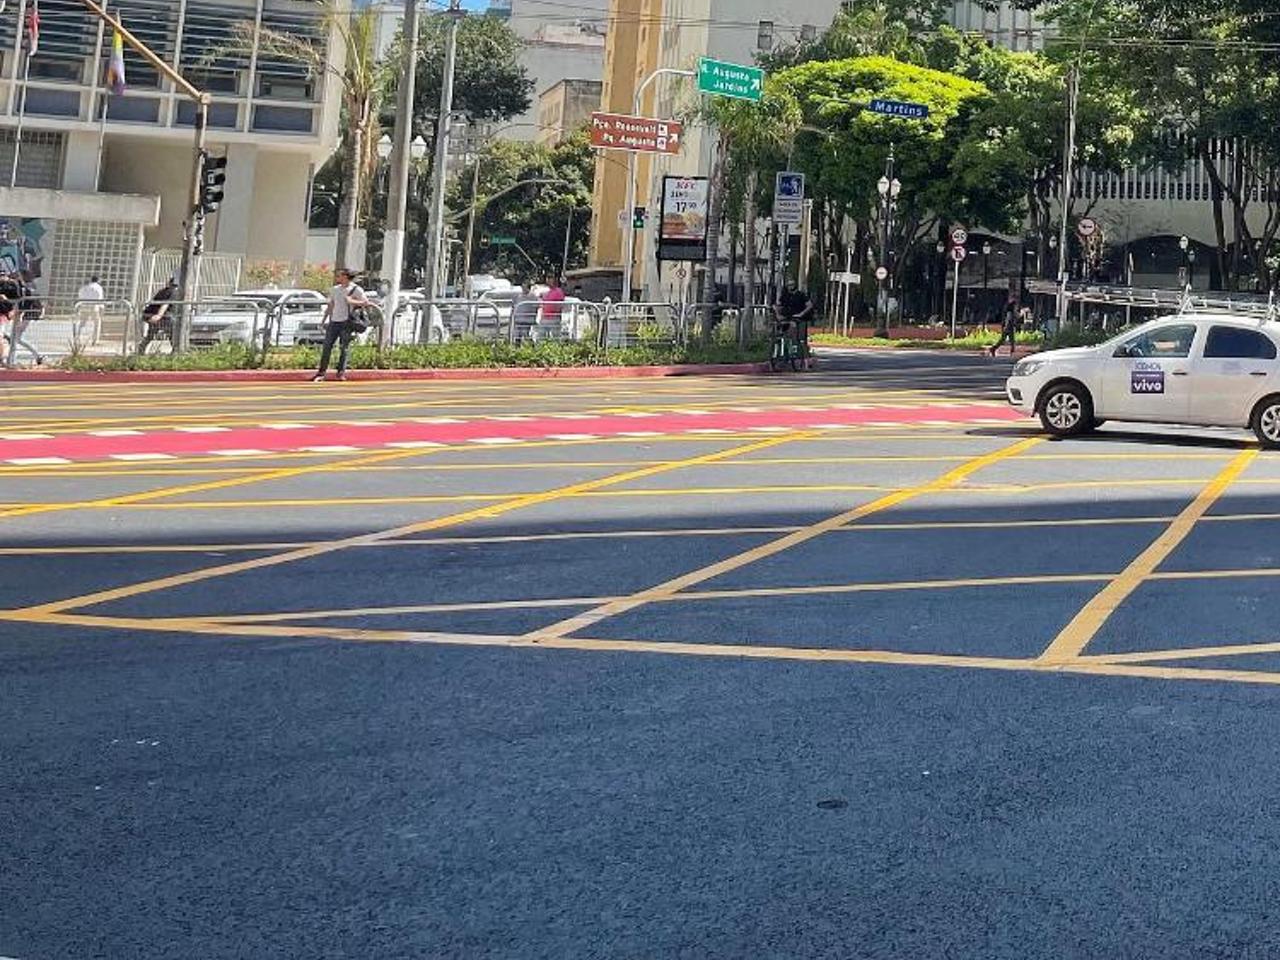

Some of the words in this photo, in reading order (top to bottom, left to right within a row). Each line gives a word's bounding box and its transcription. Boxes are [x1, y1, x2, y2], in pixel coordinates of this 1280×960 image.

[713, 66, 750, 82] Augusta
[713, 80, 749, 94] Jardins
[874, 101, 923, 116] Martins
[1133, 378, 1162, 391] vivo
